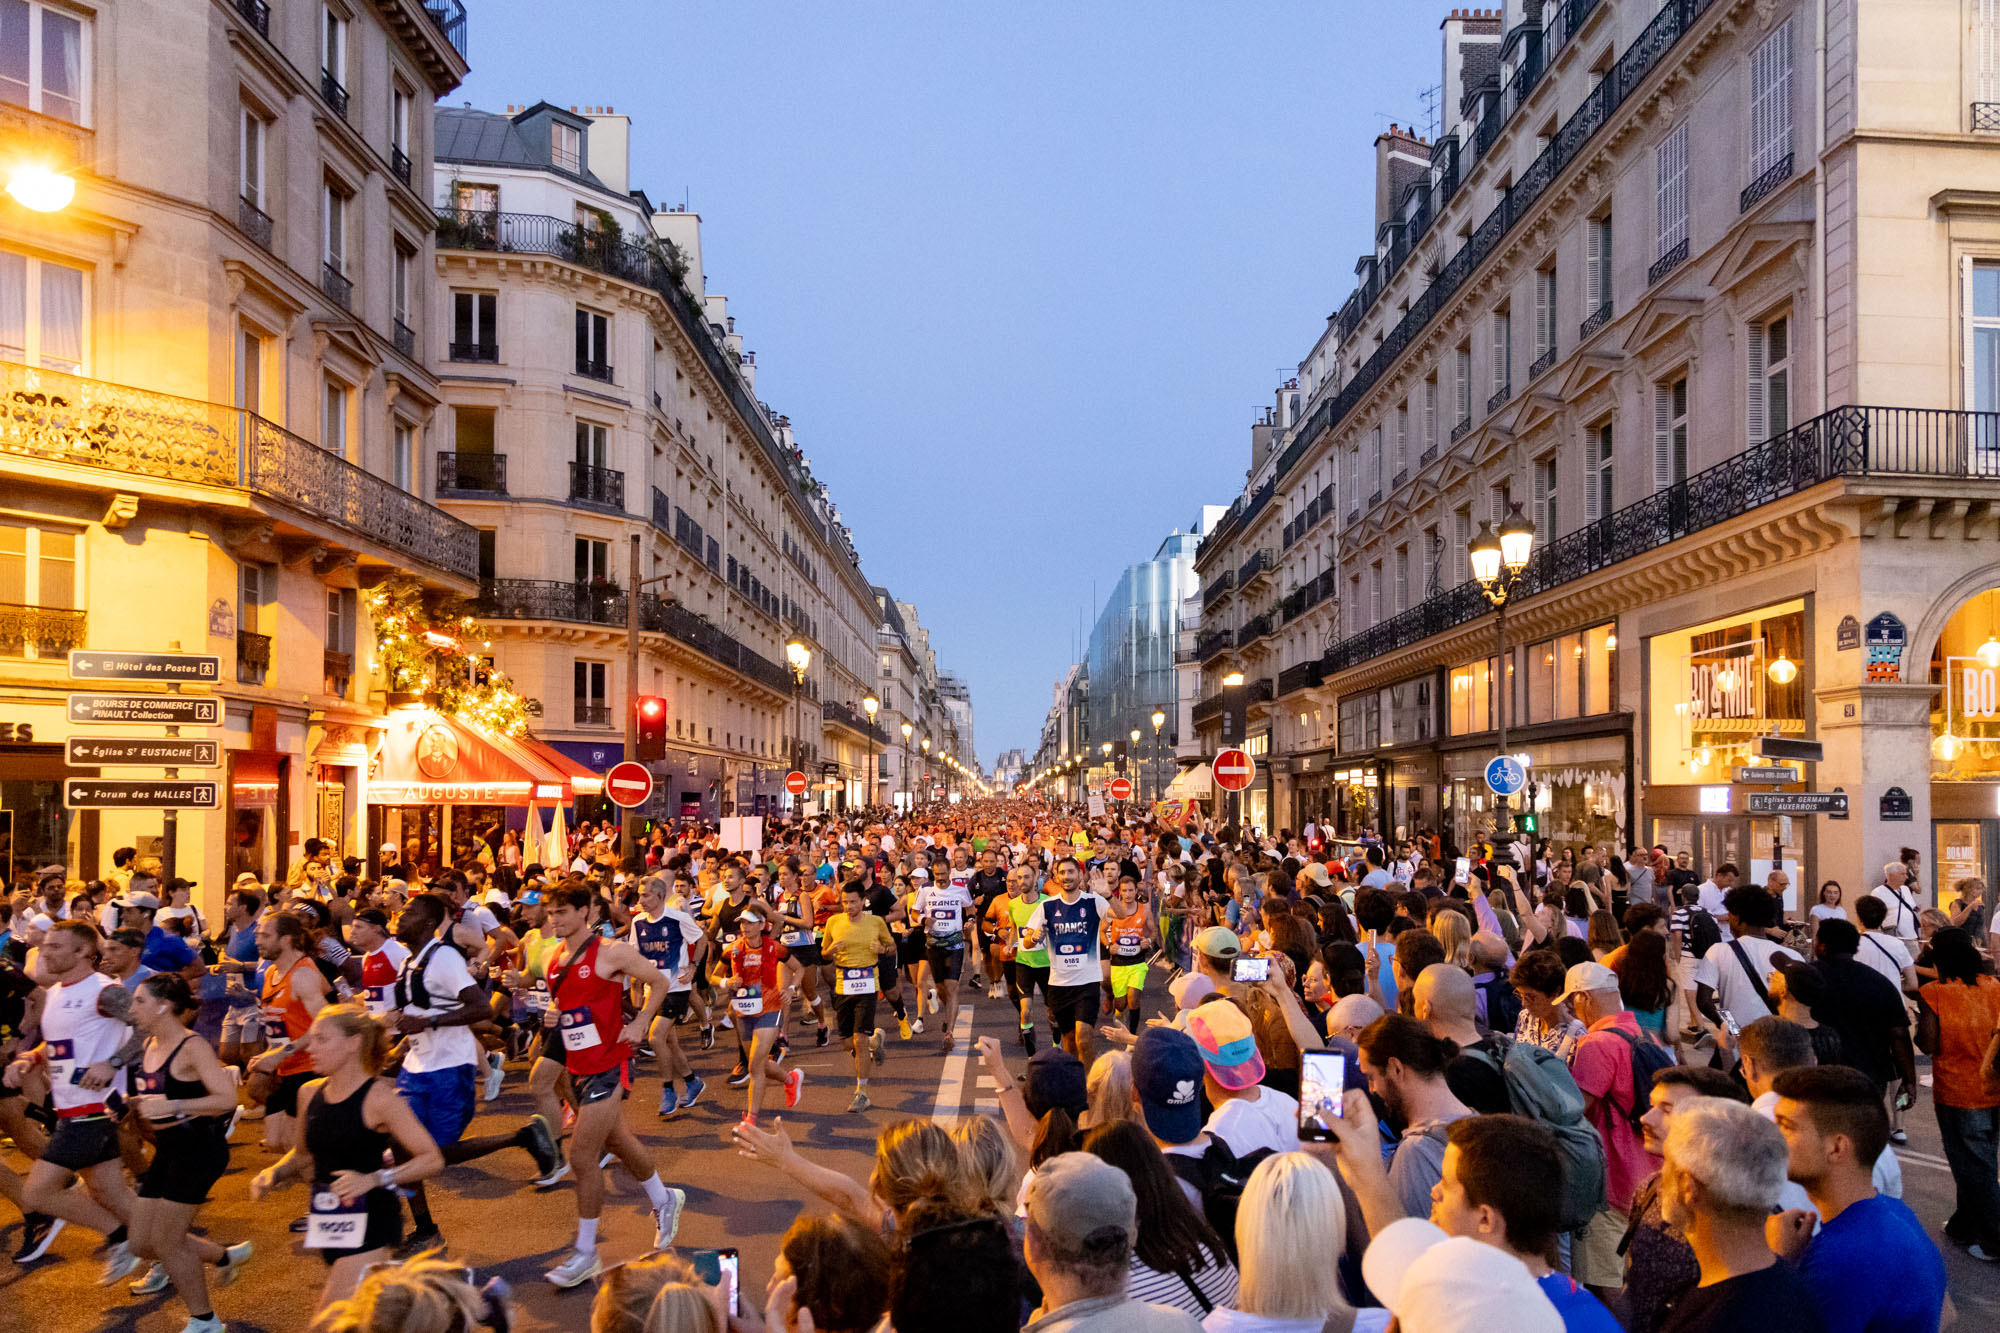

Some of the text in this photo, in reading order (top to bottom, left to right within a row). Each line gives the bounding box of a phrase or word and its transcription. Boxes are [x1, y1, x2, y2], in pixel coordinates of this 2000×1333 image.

[116, 662, 197, 673] Hôtel des Postes
[92, 699, 194, 710] BOURSE DE COMMERCE
[92, 710, 174, 720] PINAULT Collection
[140, 748, 192, 757] EUSTACHE
[94, 790, 192, 799] Forum des HALLES
[404, 787, 495, 800] AUGUSTE
[1797, 796, 1830, 804] GERMAIN
[927, 899, 960, 907] FRANCE
[1053, 921, 1088, 936] FRANCE
